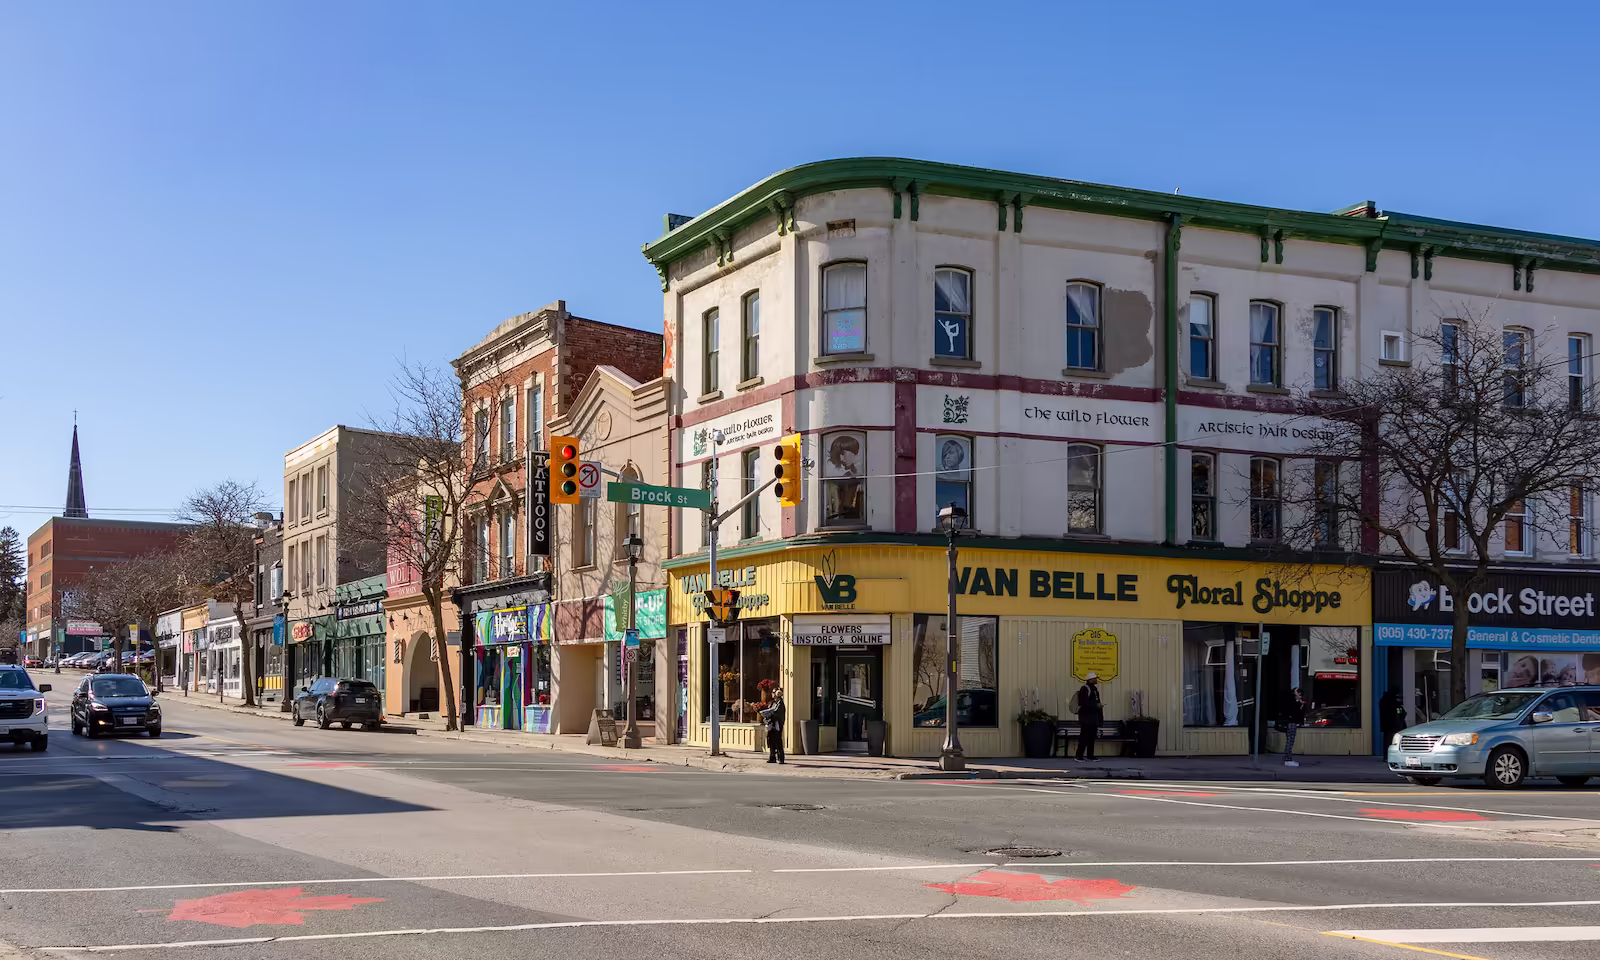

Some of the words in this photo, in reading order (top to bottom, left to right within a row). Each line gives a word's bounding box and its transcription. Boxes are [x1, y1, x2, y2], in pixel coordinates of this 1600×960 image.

[534, 455, 546, 542] TATTOOS
[631, 487, 672, 503] Brock
[677, 494, 688, 504] St
[681, 572, 707, 594] VAN
[814, 574, 857, 603] VB
[955, 566, 1019, 597] VAN
[1029, 569, 1139, 602] BELLE
[1166, 574, 1244, 609] Floral
[1252, 577, 1341, 614] Shoppe
[1439, 585, 1514, 614] Bock
[1518, 587, 1595, 617] Street
[643, 614, 665, 627] STORE
[821, 625, 862, 634] FLOWERS
[796, 635, 833, 644] INSTORE
[839, 636, 845, 644] &
[851, 635, 883, 643] ONLINE
[1377, 626, 1405, 641] (905)
[1467, 629, 1509, 642] General
[1510, 631, 1519, 643] &
[1521, 631, 1570, 644] Cosmetic
